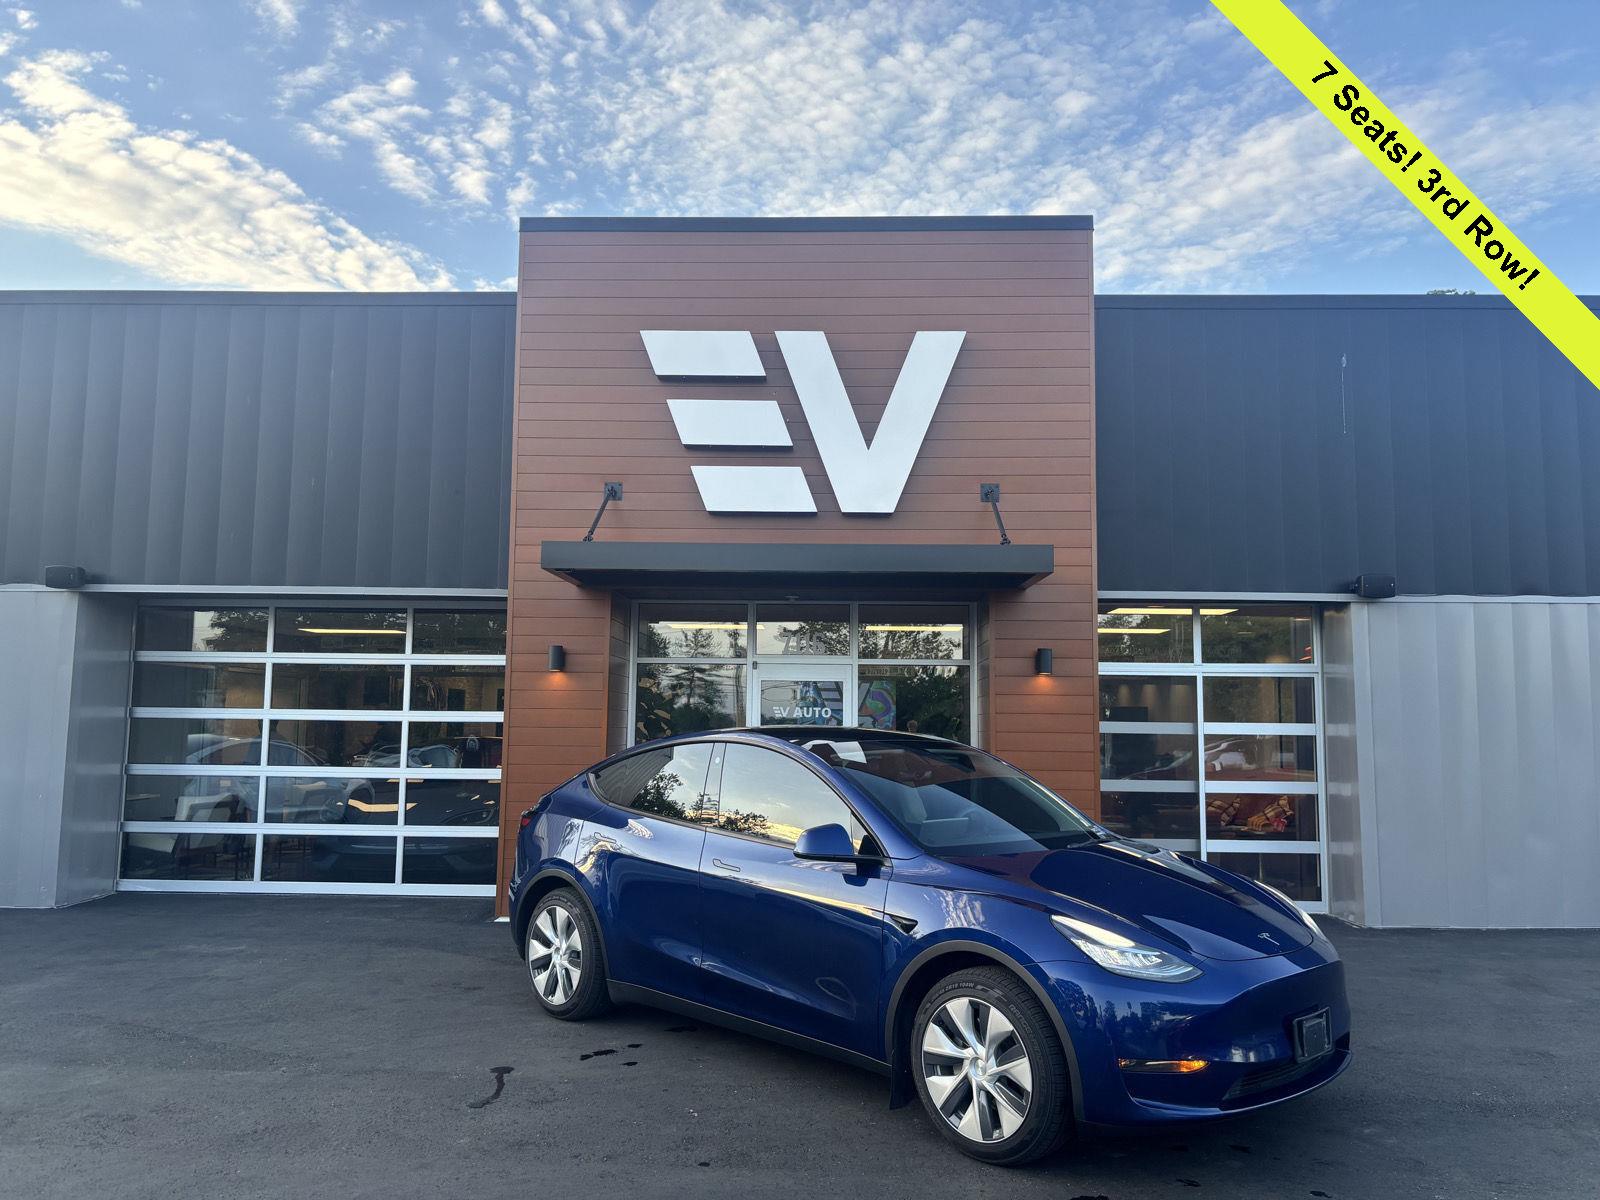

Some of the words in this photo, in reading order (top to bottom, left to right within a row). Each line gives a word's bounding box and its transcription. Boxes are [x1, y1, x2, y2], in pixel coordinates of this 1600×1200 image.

[639, 329, 967, 516] EV
[772, 706, 791, 718] EV
[793, 707, 832, 719] AUTO
